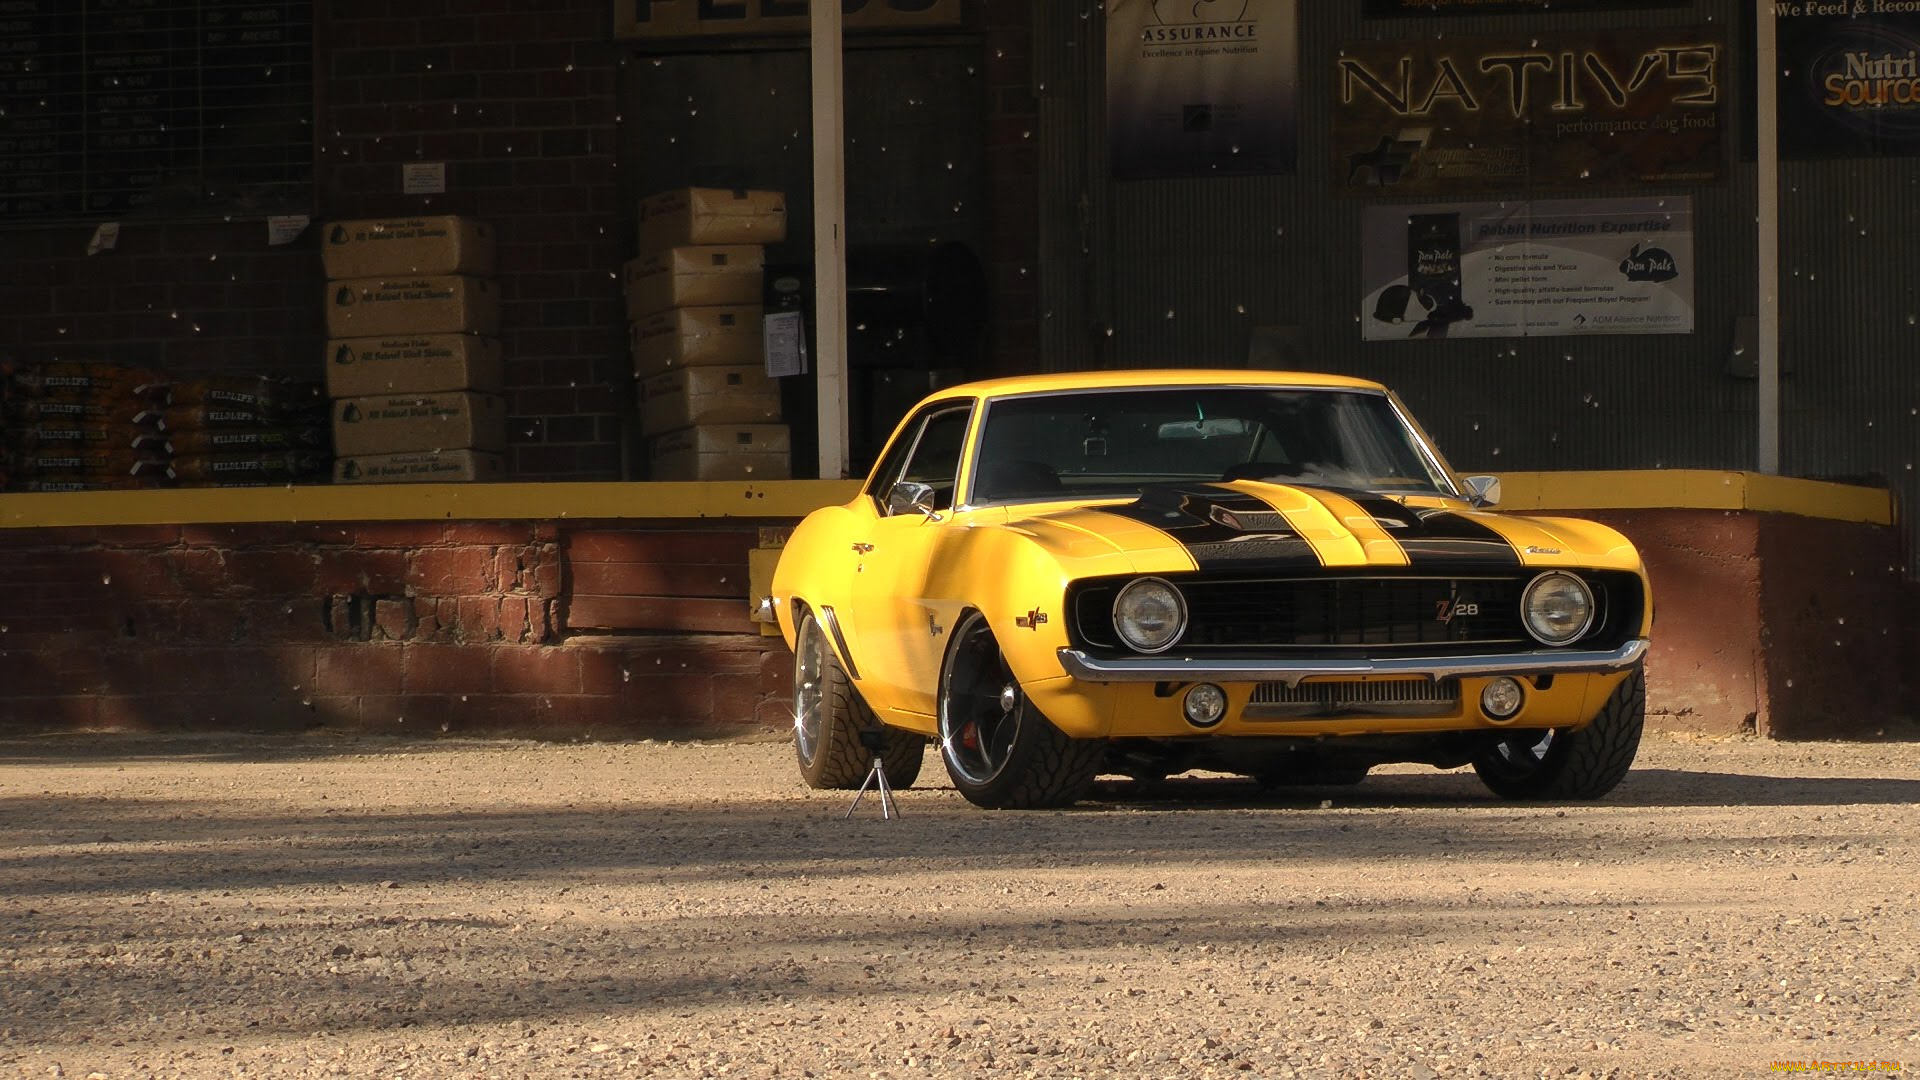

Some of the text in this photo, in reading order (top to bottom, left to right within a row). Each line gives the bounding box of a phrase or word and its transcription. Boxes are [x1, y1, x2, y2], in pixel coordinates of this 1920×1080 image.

[1776, 2, 1801, 17] We
[1806, 1, 1848, 16] Feed
[1853, 0, 1868, 14] &
[1143, 25, 1256, 42] ASSURANCE
[1142, 49, 1183, 59] Excellence
[1194, 48, 1220, 58] Equine
[1222, 46, 1258, 55] Nutrition
[1844, 50, 1917, 80] Nutri
[1338, 44, 1718, 118] NATIVE
[1824, 73, 1920, 107] Source
[1556, 115, 1648, 137] performance
[1682, 111, 1716, 129] food
[1478, 220, 1671, 236] Rabbit Nutrition Expertise
[1626, 257, 1672, 273] Pen Pals
[1566, 297, 1597, 305] Frequent
[1592, 314, 1681, 324] ADM Alliance Nutrition
[212, 433, 257, 444] WILDLIFE
[1434, 594, 1480, 626] Z/28
